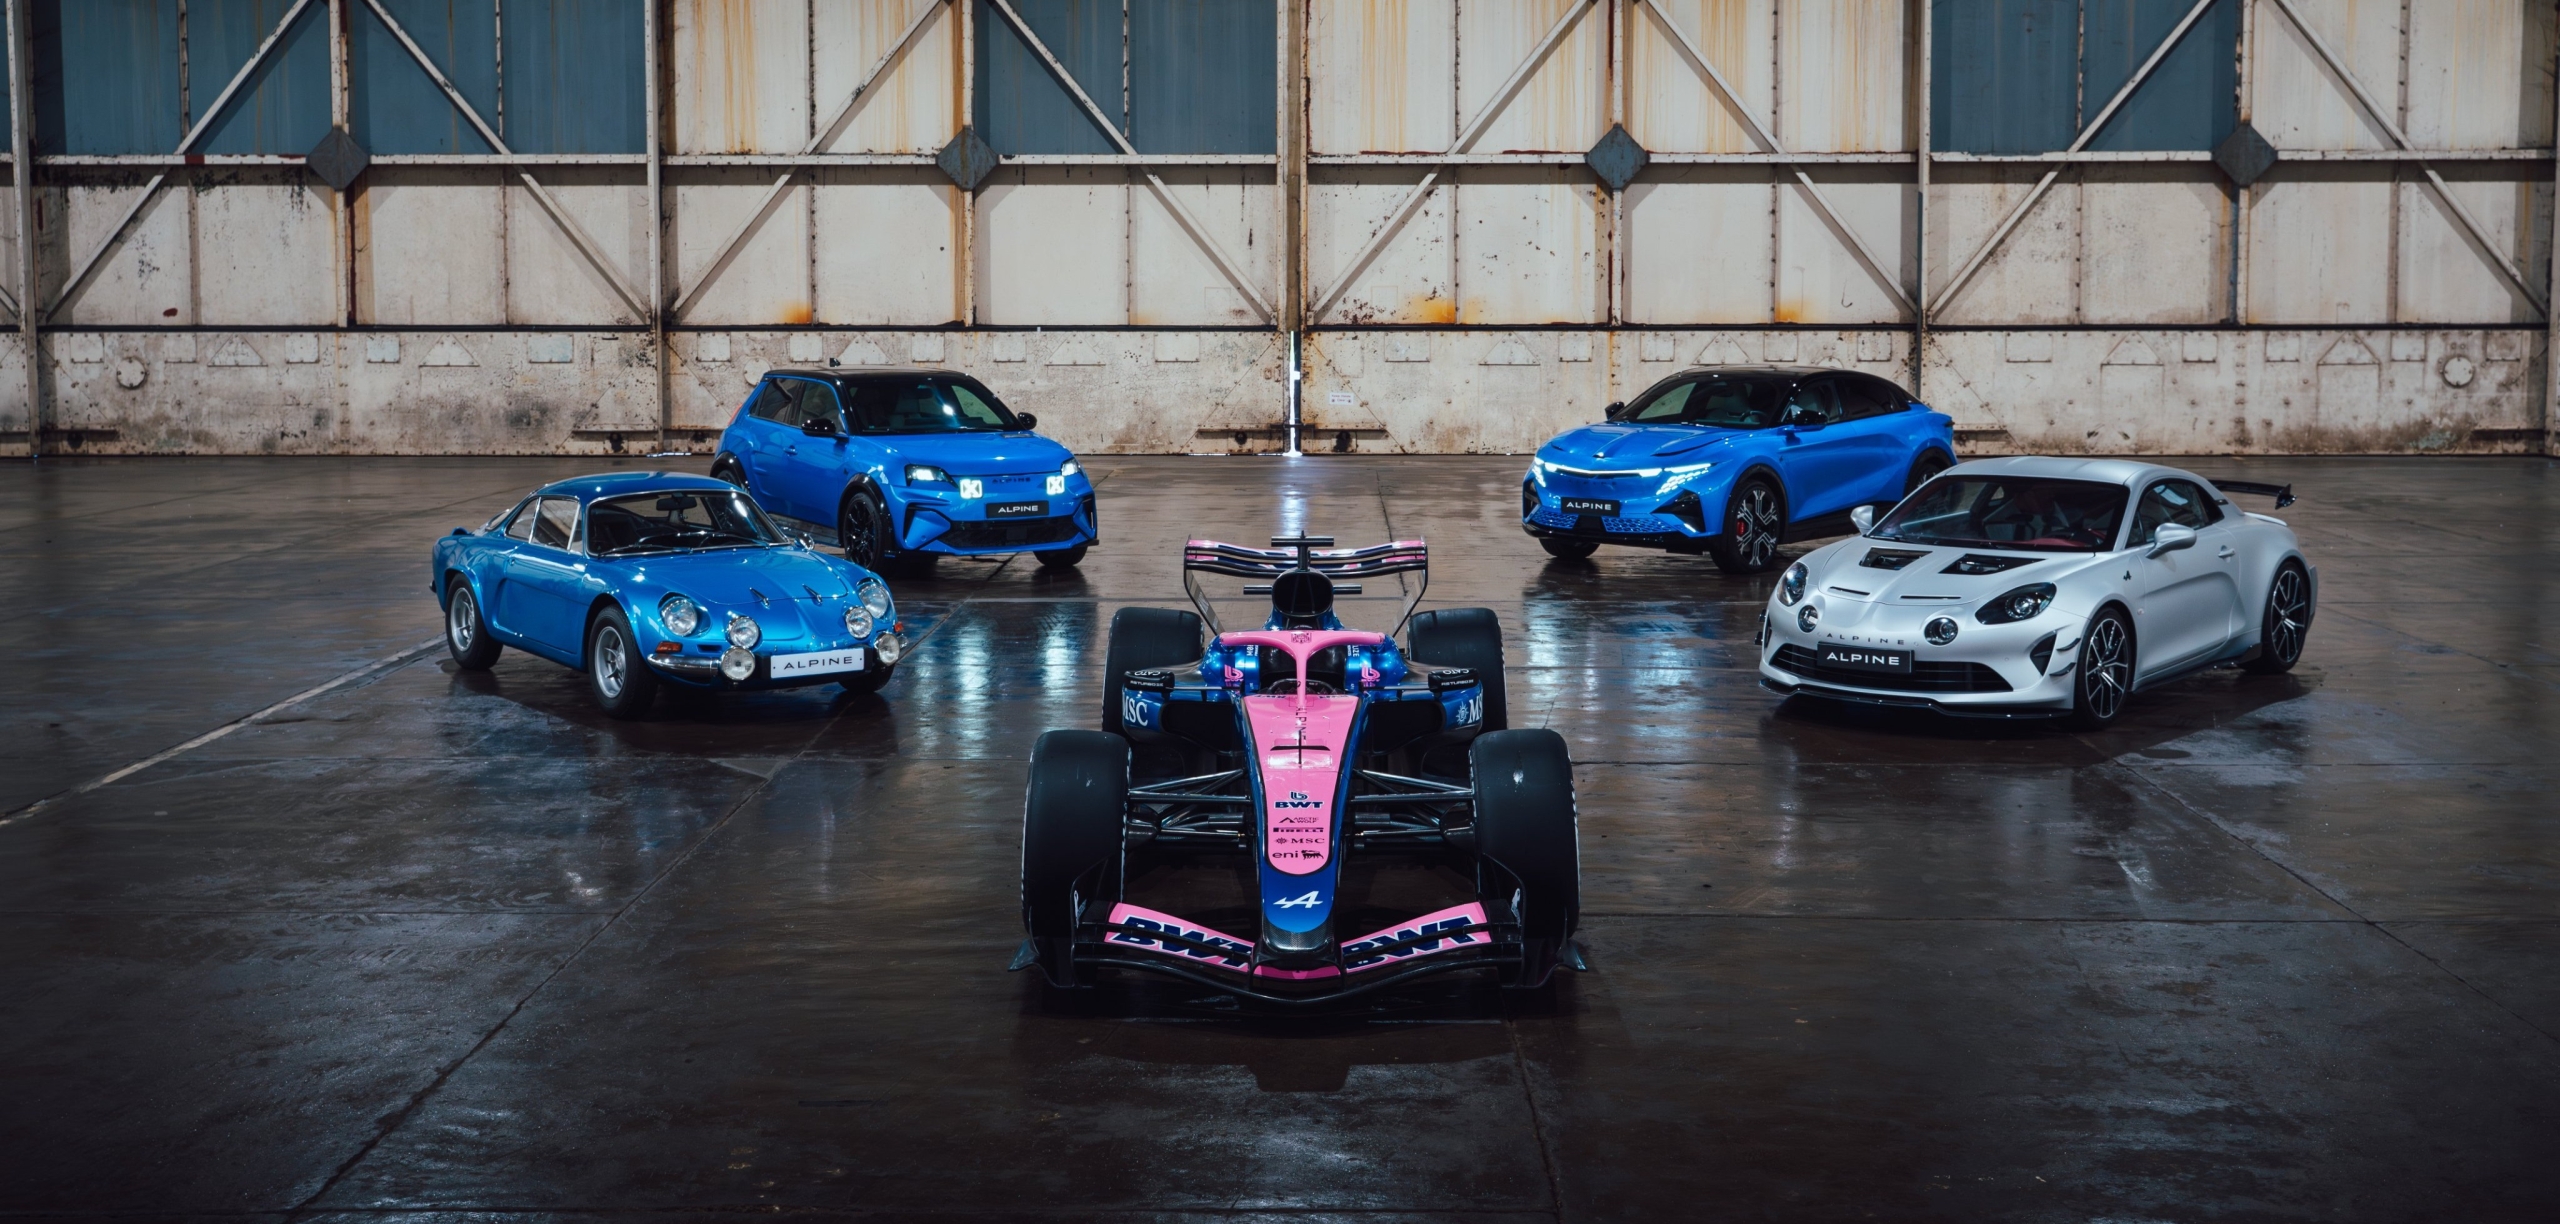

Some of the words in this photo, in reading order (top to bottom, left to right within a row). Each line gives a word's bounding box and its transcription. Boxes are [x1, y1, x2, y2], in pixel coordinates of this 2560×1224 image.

[997, 505, 1039, 513] ALPINE
[1566, 501, 1612, 511] ALPINE
[1826, 632, 1905, 646] ALPINE
[783, 656, 854, 671] ALPINE
[1826, 651, 1900, 666] ALPINE
[1274, 801, 1324, 809] BWT
[1272, 850, 1299, 858] eni
[1109, 914, 1252, 969] BWT
[1341, 914, 1477, 970] BWT
